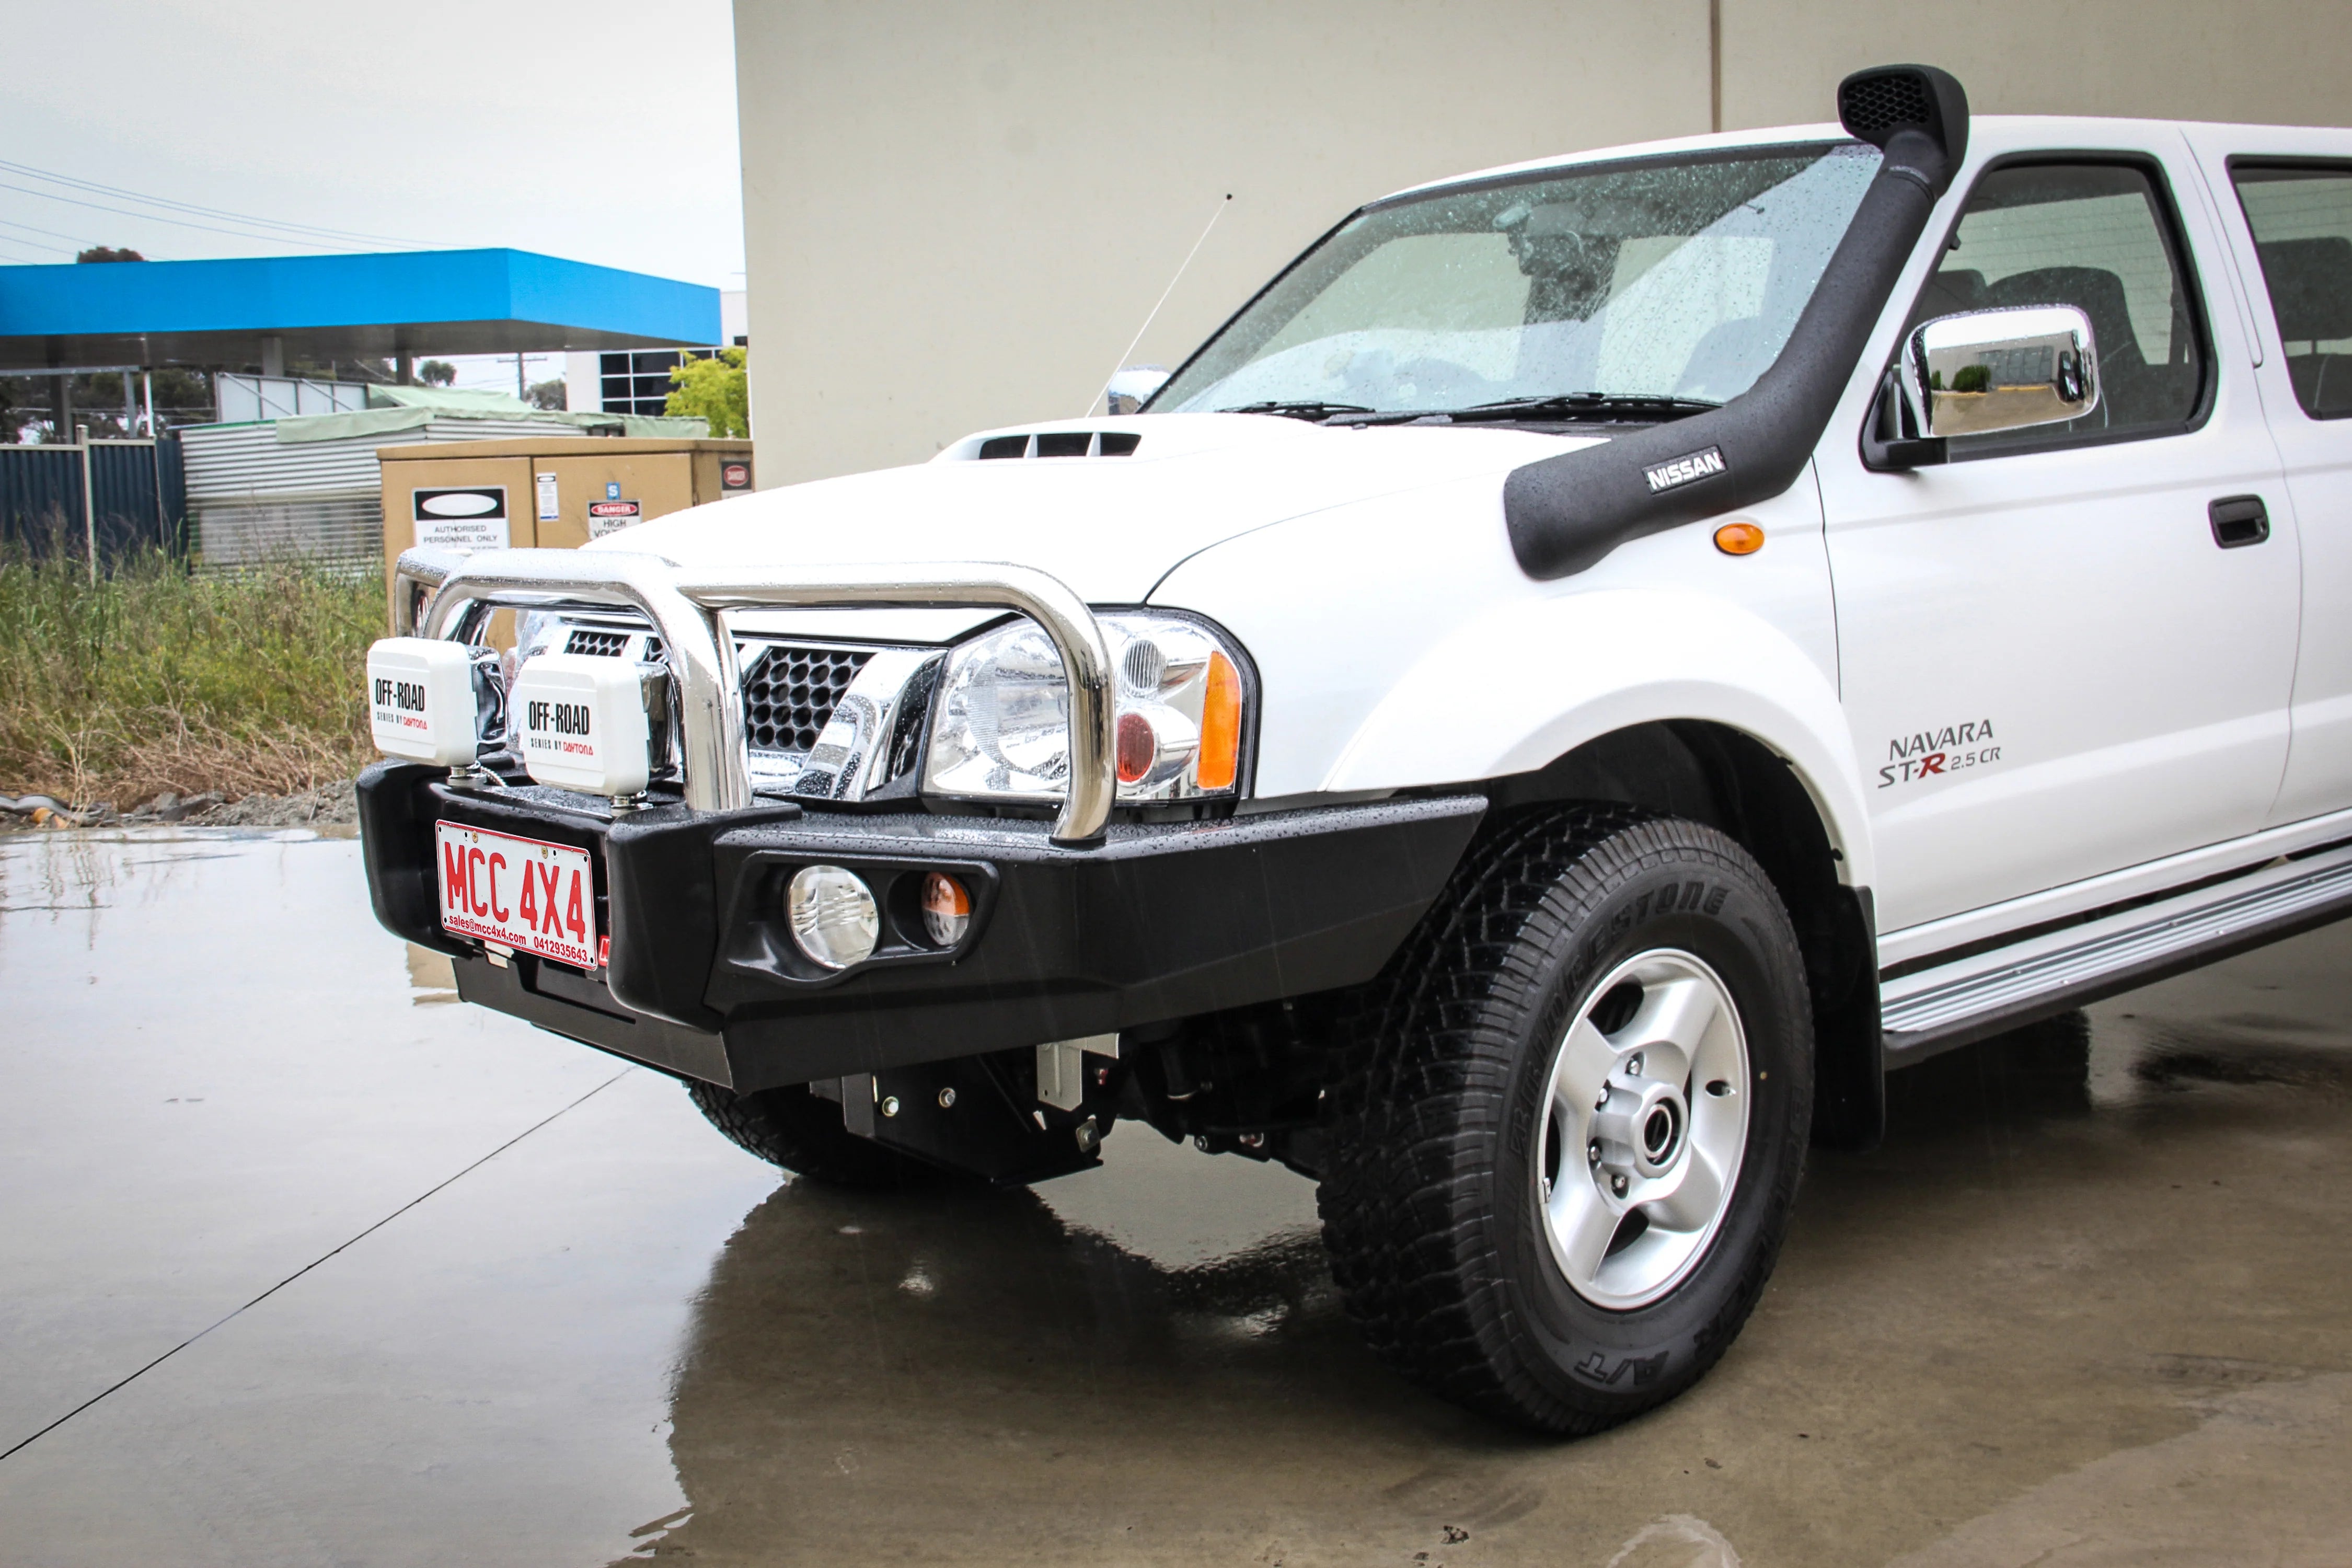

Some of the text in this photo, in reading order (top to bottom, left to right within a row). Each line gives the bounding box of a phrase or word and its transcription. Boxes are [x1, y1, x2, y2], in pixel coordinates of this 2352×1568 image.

[1647, 452, 1723, 490] NISSAN
[608, 485, 618, 497] S
[434, 525, 487, 533] AUTHORISED
[604, 518, 626, 527] HIGH
[376, 678, 425, 712] OFF-ROAD
[377, 711, 428, 730] SERIES BY DAYTONA
[528, 700, 590, 735] OFF-ROAD
[531, 737, 594, 756] SERIES BY DAYTONA
[1889, 719, 1993, 761] NAVARA
[1878, 747, 2001, 788] ST-R 2.5 CR
[444, 841, 585, 944] MCC 4X4
[449, 915, 526, 945] sales@mcc4x4.com
[533, 936, 587, 962] 0412935643
